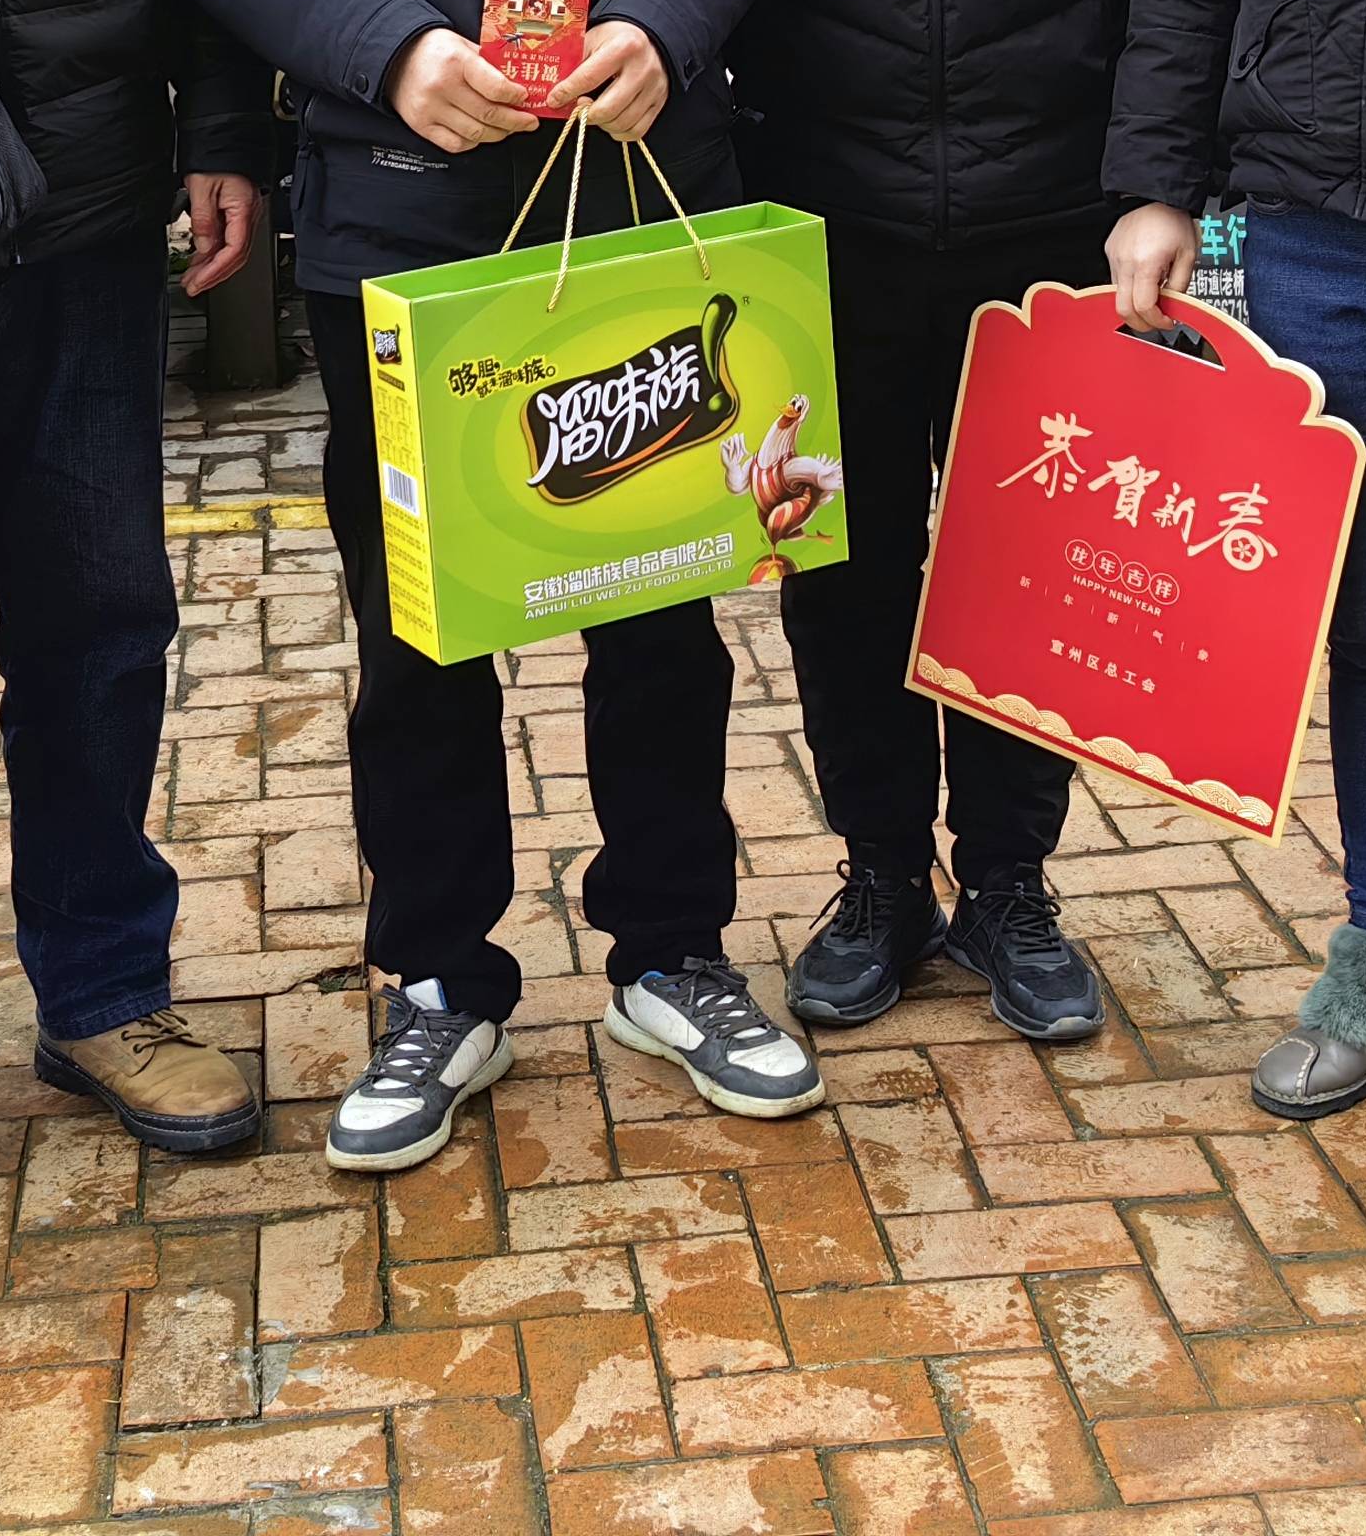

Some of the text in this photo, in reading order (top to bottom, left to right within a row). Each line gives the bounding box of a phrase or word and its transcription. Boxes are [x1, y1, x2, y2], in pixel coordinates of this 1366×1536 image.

[525, 603, 567, 620] ANHUI
[571, 595, 592, 608] LIU
[596, 589, 621, 603] WEI
[625, 583, 642, 595] ZU
[646, 572, 681, 589] FOOD
[1073, 573, 1163, 617] HAPPY NEW YEAR
[1049, 639, 1156, 694] 宣州区总工会
